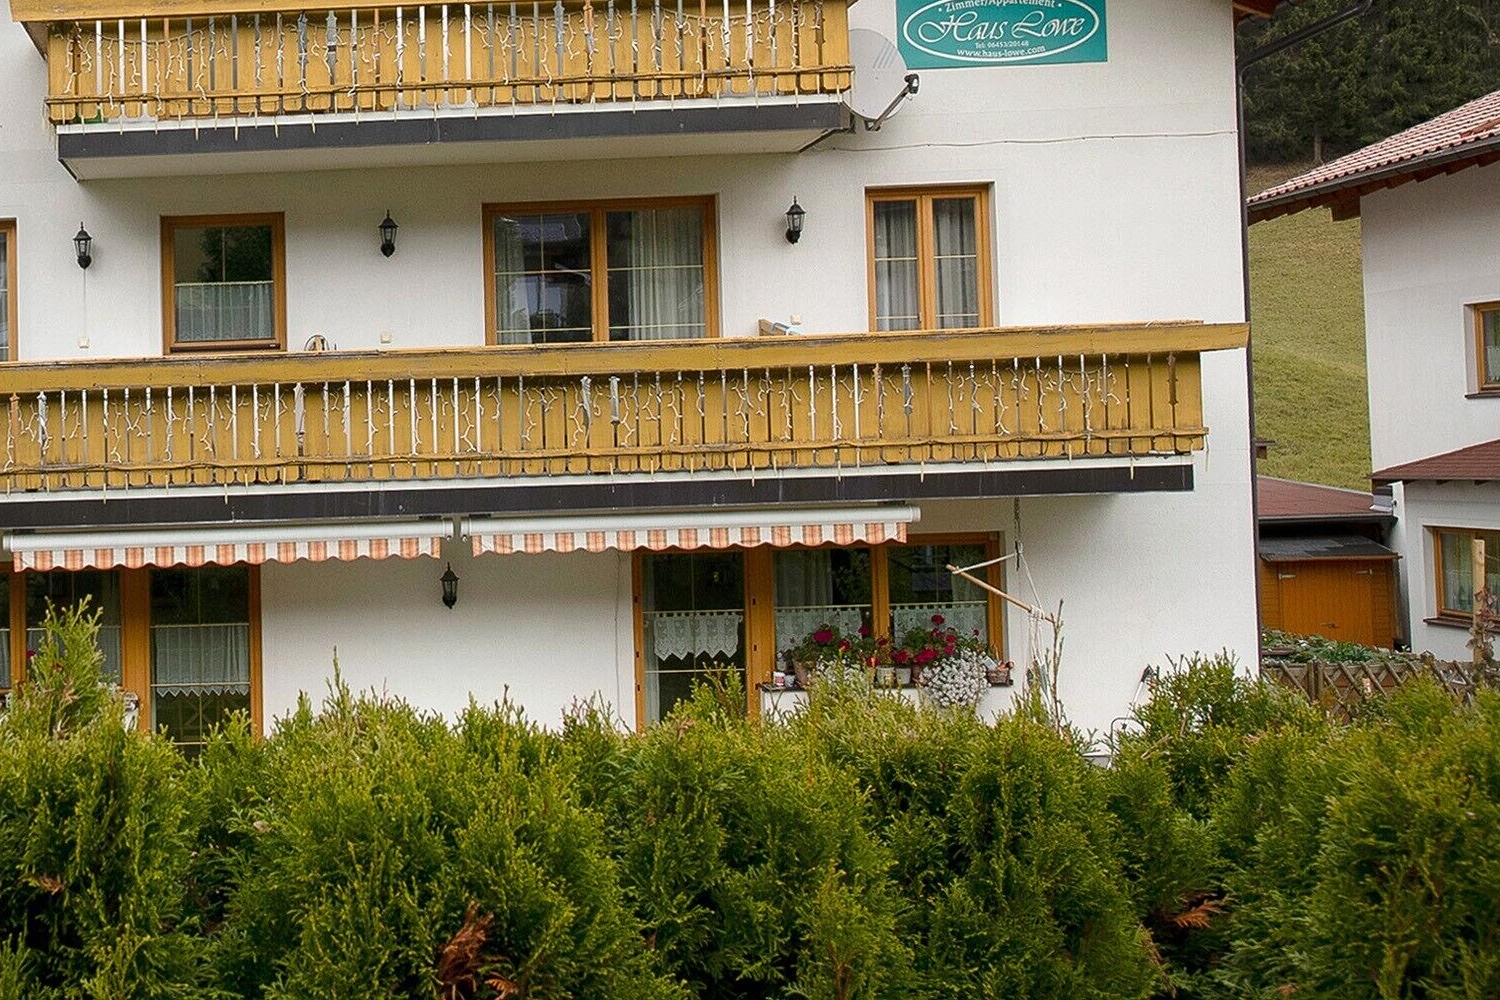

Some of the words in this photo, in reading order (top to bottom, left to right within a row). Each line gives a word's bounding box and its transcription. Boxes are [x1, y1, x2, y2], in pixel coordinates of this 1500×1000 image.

[918, 10, 1008, 42] Haus
[1011, 10, 1085, 39] Lowe
[956, 45, 1046, 58] www.haus-lowe.com
